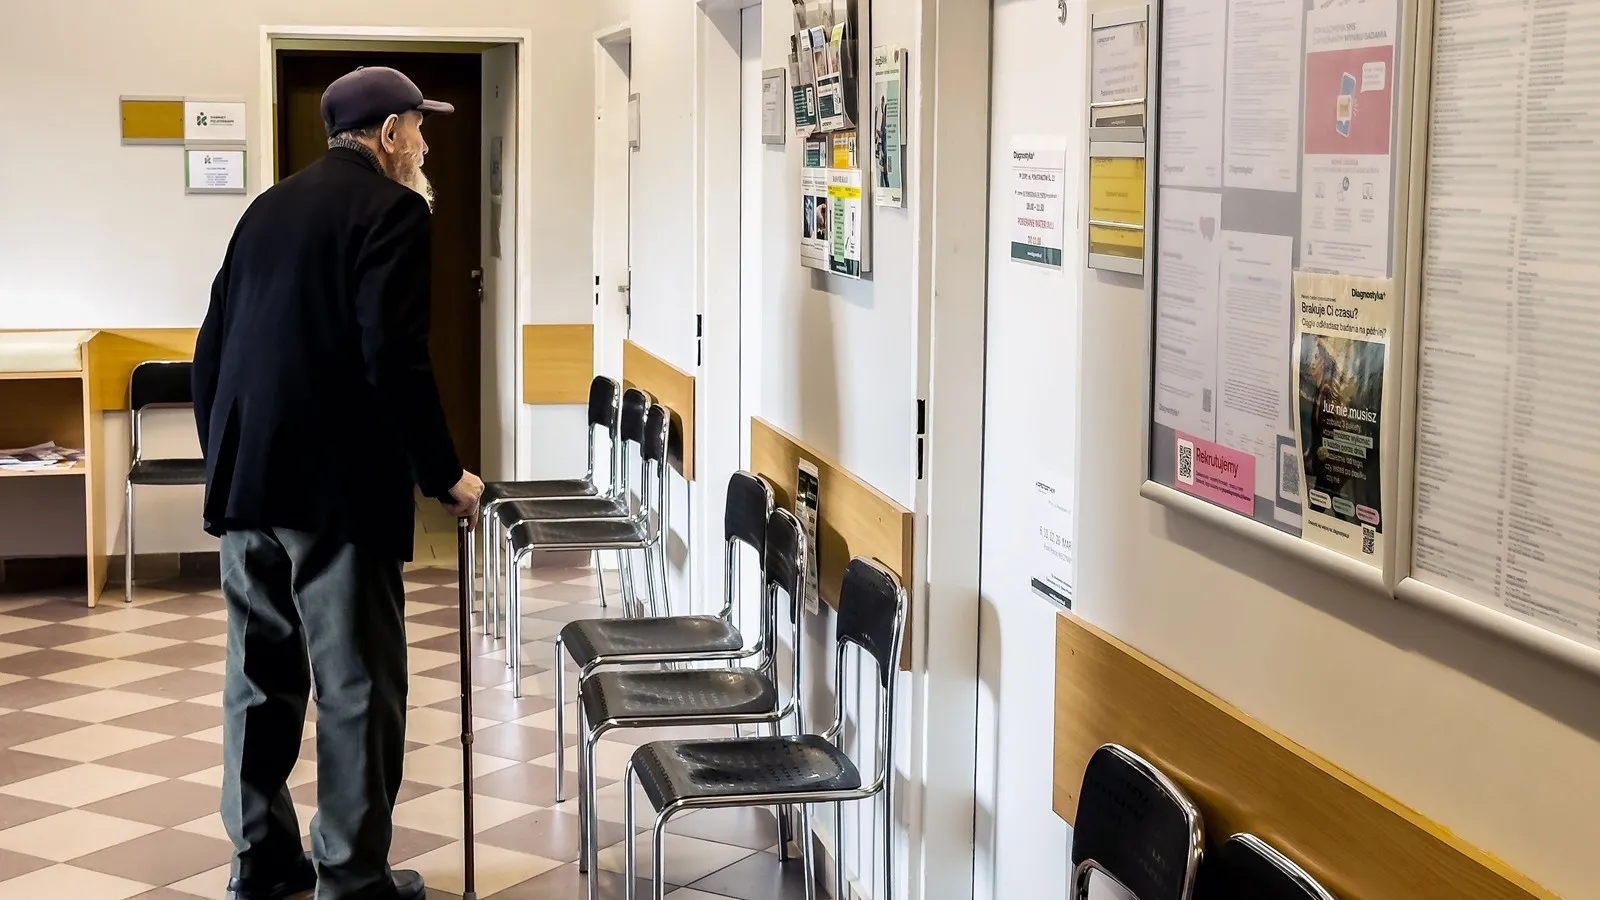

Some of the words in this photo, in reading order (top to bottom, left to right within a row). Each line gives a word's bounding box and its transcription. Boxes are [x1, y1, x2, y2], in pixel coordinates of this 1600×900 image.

[1352, 288, 1384, 301] Diagnostyka
[1302, 302, 1325, 318] Brakuje
[1326, 304, 1334, 316] Ci
[1334, 308, 1358, 319] czasu?
[1316, 320, 1339, 330] odkładasz
[1340, 323, 1358, 333] badania
[1322, 400, 1334, 414] Już
[1336, 402, 1348, 417] nie
[1349, 408, 1376, 423] musisz
[1196, 447, 1238, 478] Rekrutujemy
